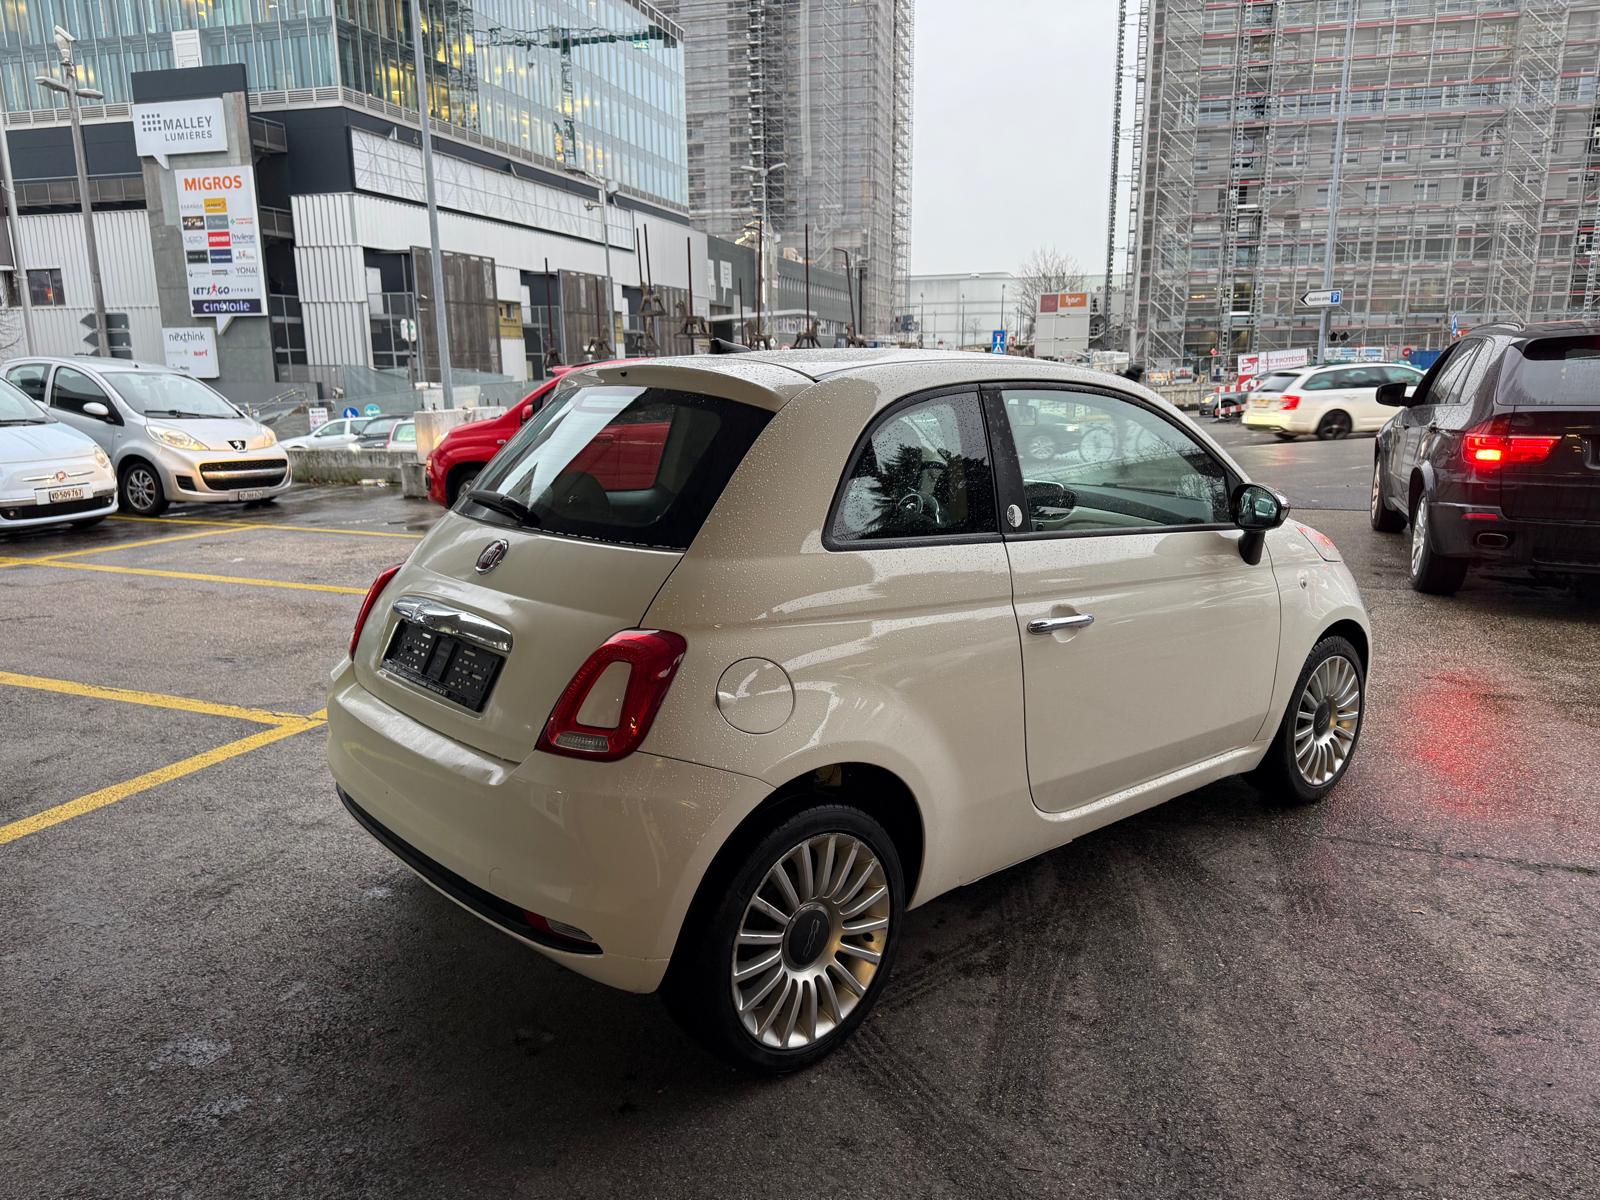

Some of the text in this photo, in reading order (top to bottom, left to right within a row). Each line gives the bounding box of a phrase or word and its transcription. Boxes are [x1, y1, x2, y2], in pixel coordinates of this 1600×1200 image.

[163, 115, 212, 131] MALLEY
[183, 175, 242, 191] MIGROS
[193, 286, 211, 295] LET'S
[218, 286, 230, 295] GO
[168, 330, 206, 343] nexthink
